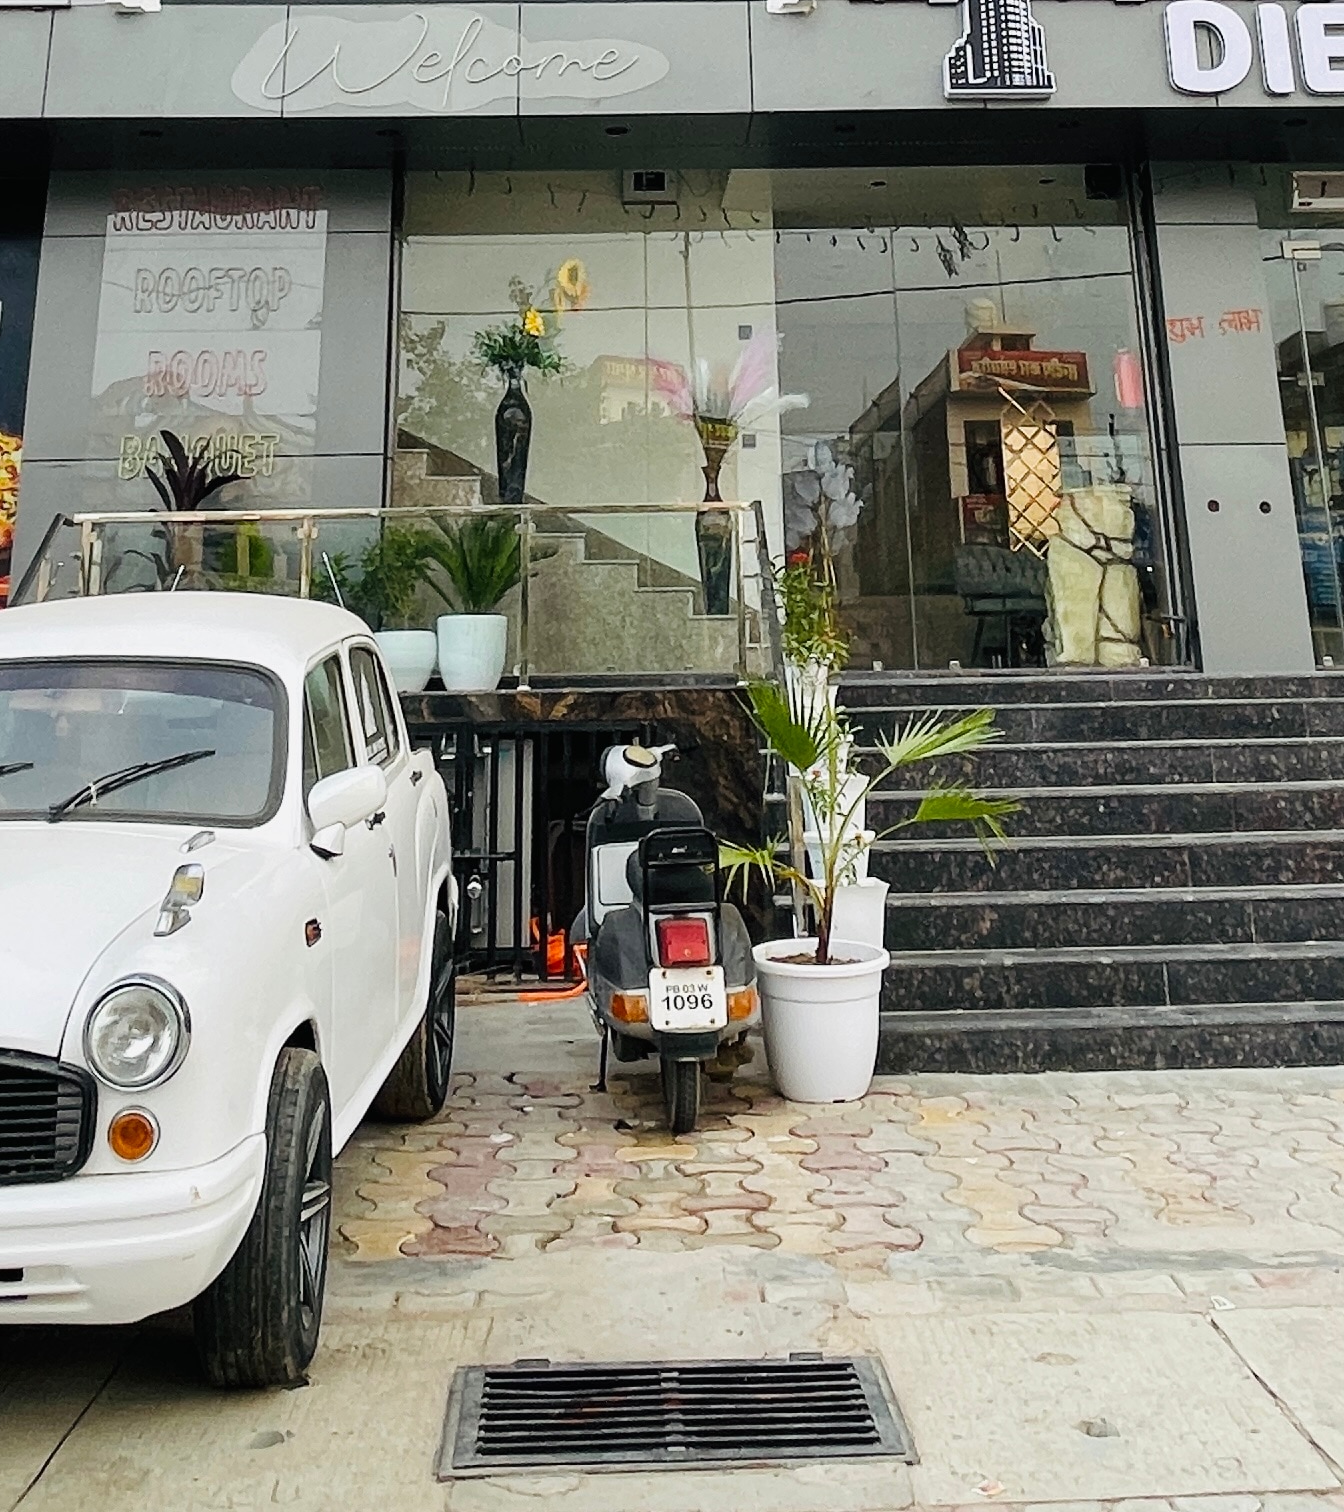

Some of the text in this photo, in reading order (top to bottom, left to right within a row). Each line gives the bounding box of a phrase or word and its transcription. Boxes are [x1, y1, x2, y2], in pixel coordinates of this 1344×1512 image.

[262, 12, 640, 107] Welcome
[111, 186, 322, 231] RESTAURANT
[132, 266, 294, 314] ROOFTOP
[144, 349, 268, 398] ROOMS
[661, 993, 713, 1011] 1096
